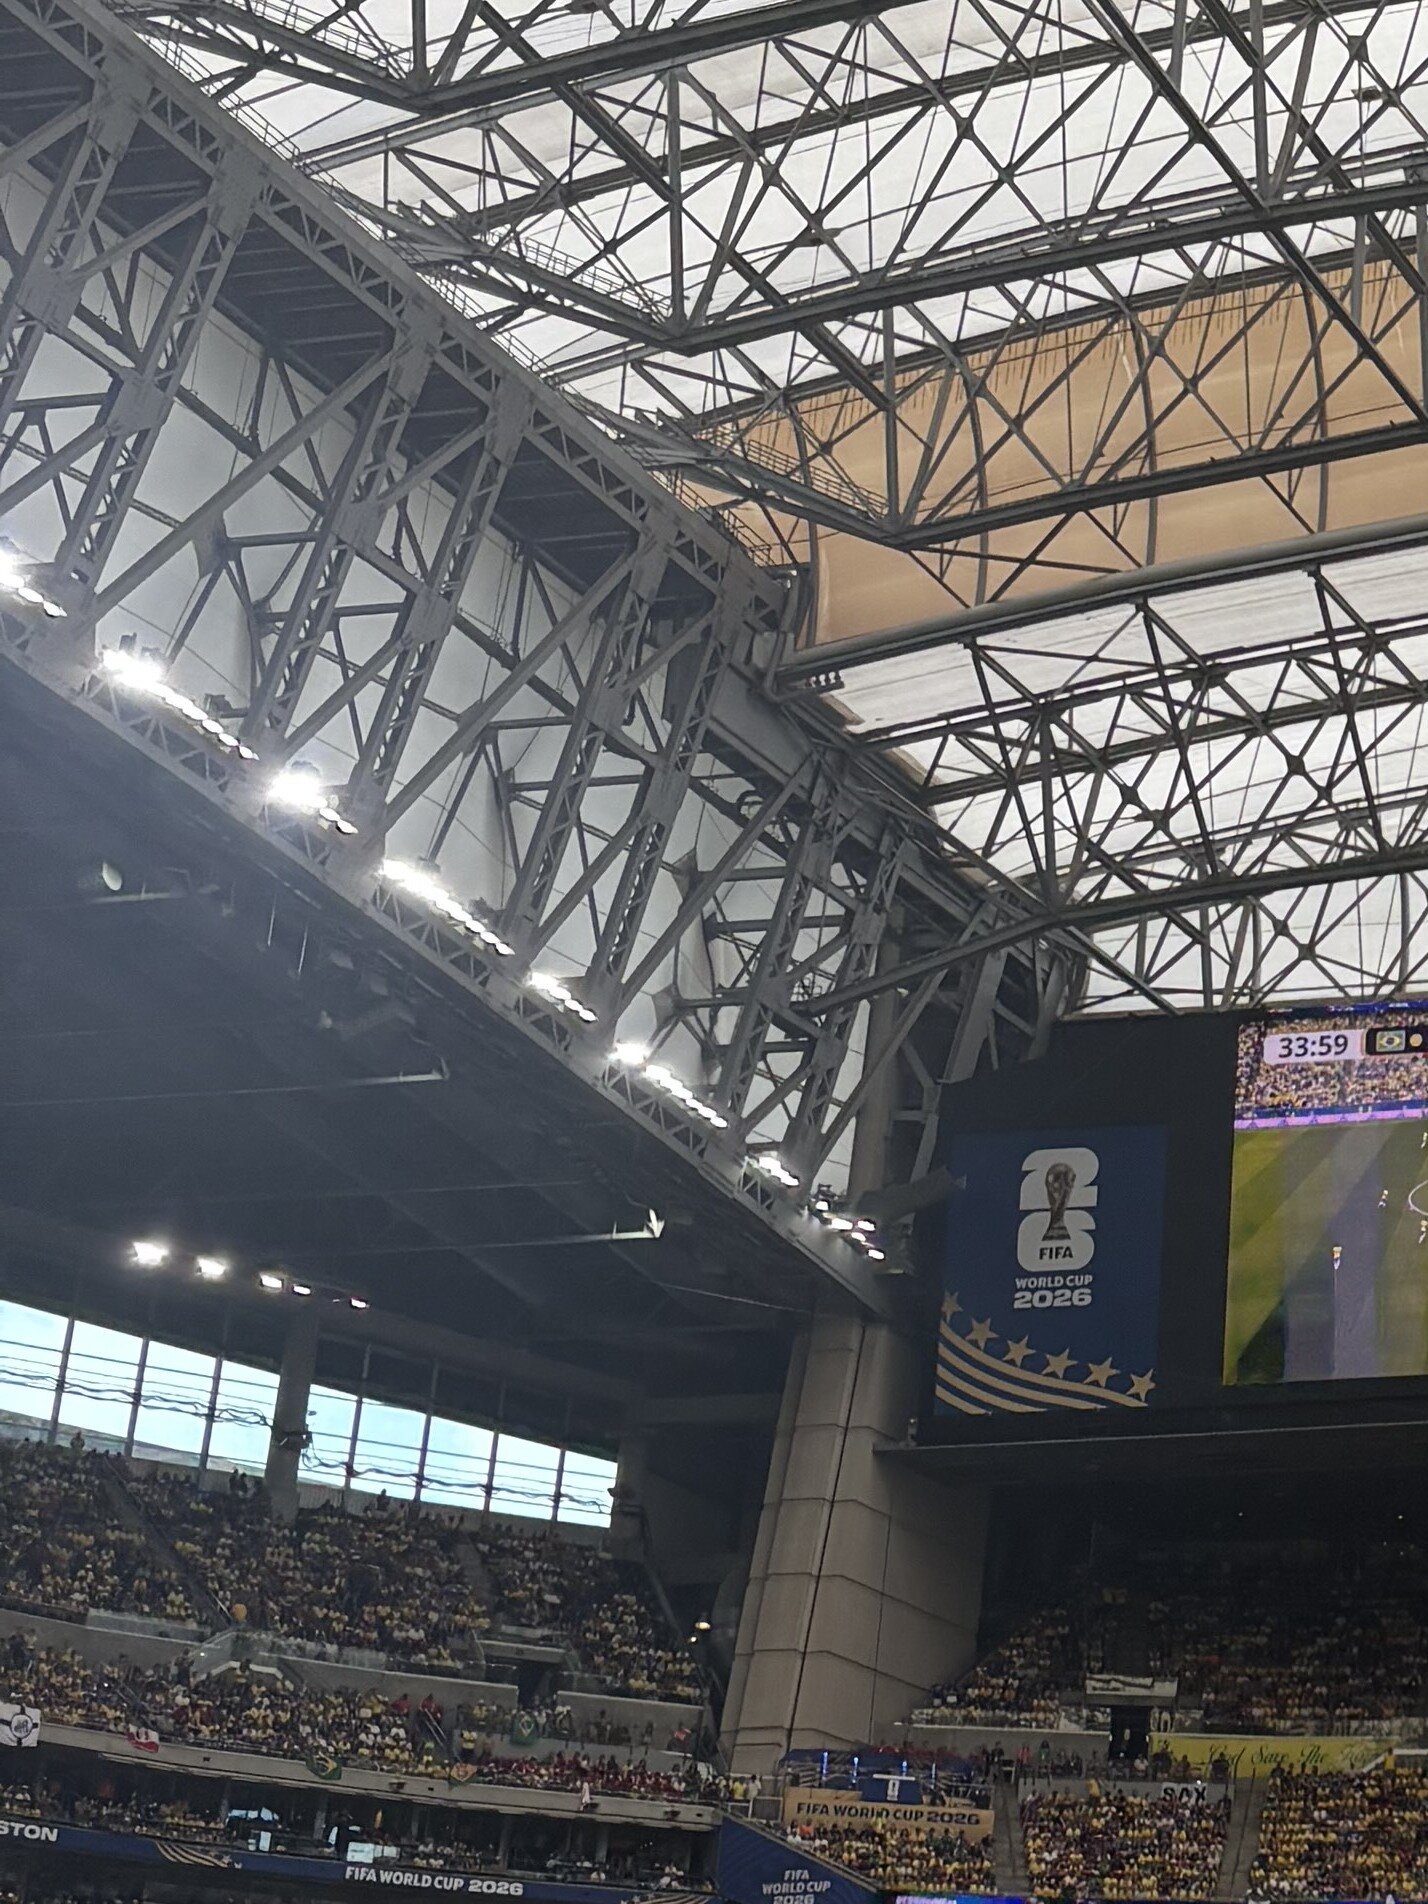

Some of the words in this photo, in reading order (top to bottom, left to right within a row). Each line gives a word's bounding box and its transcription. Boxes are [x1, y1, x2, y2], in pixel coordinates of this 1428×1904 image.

[1278, 1033, 1349, 1059] 33:59
[1039, 1246, 1074, 1260] FIFA
[1015, 1275, 1064, 1289] WORLD
[1065, 1274, 1093, 1287] CUP
[1013, 1288, 1092, 1309] 2026
[796, 1802, 830, 1816] FIFA
[833, 1806, 890, 1819] WORLD
[892, 1809, 924, 1822] CUP
[926, 1811, 982, 1825] 2026
[345, 1866, 377, 1884] FIFA
[378, 1869, 433, 1889] WORLD
[434, 1874, 464, 1892] CUP
[468, 1879, 525, 1897] 2026
[784, 1869, 810, 1880] FIFA
[762, 1881, 807, 1895] WORLD
[807, 1880, 831, 1893] CUP
